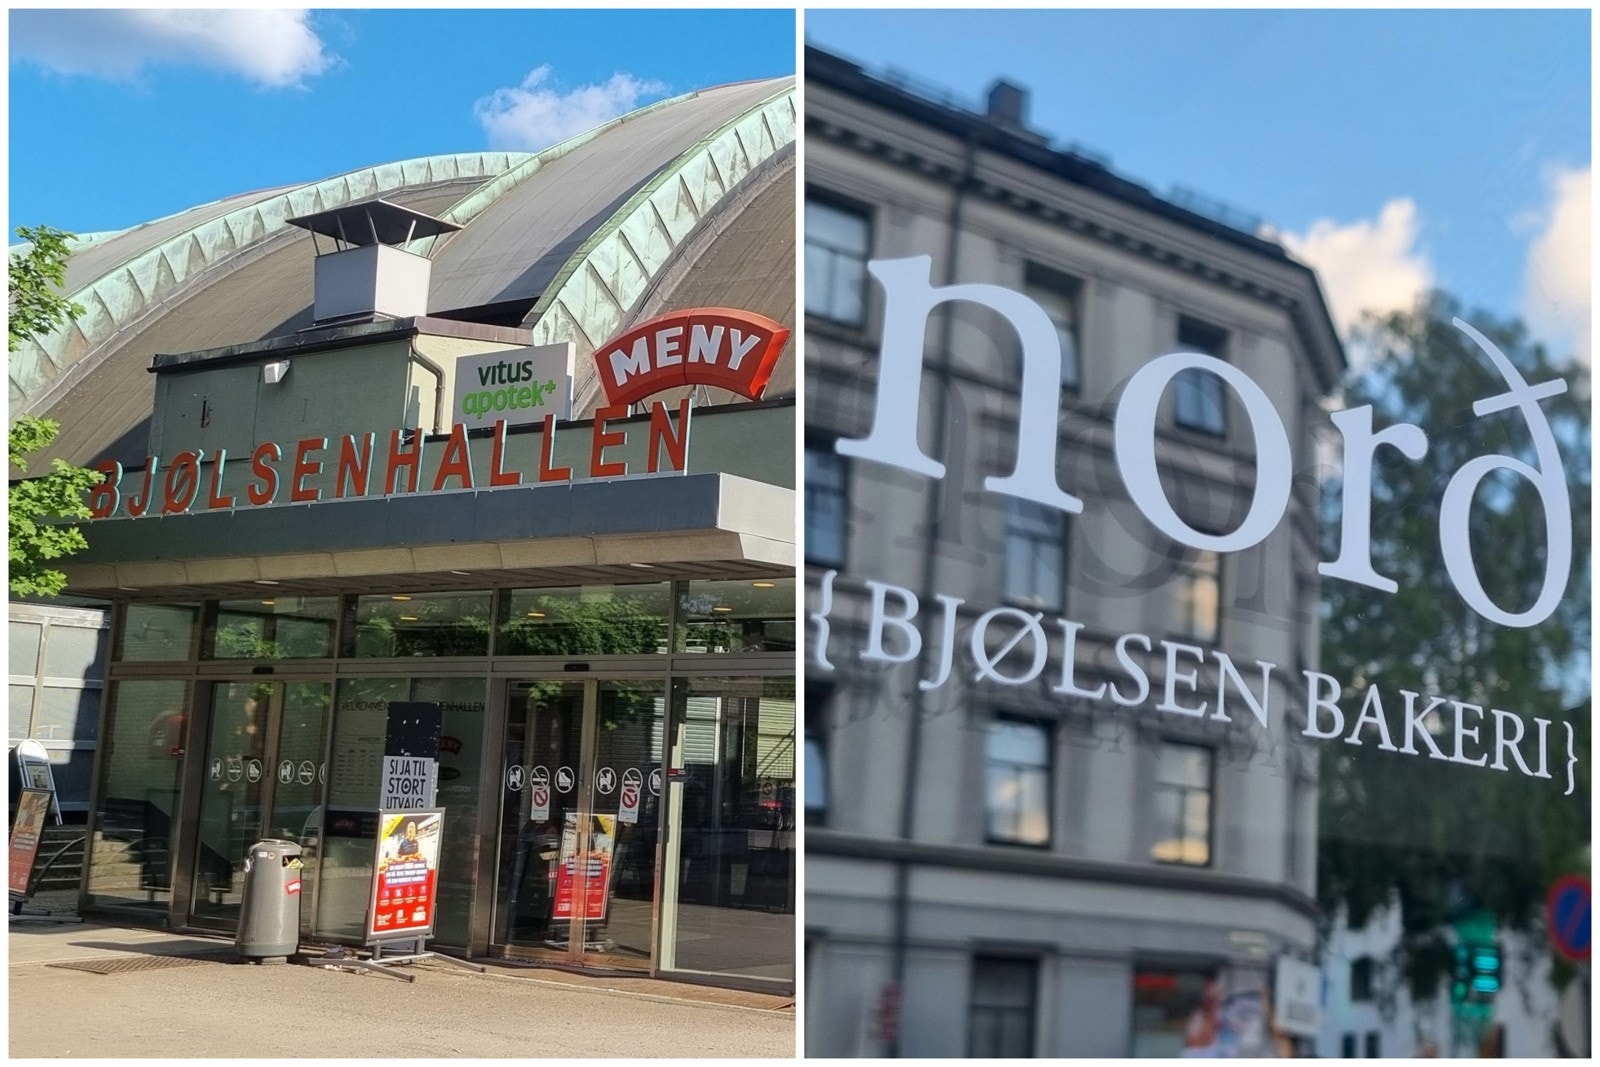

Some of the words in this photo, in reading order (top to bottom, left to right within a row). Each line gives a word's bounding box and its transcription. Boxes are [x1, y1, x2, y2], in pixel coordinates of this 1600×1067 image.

[609, 324, 761, 387] MENY
[477, 359, 533, 387] vitus
[90, 398, 692, 518] BJØLSENHALLEN
[389, 759, 399, 775] SI
[400, 760, 411, 776] JA
[412, 760, 426, 776] TIL
[387, 777, 426, 795] STORT
